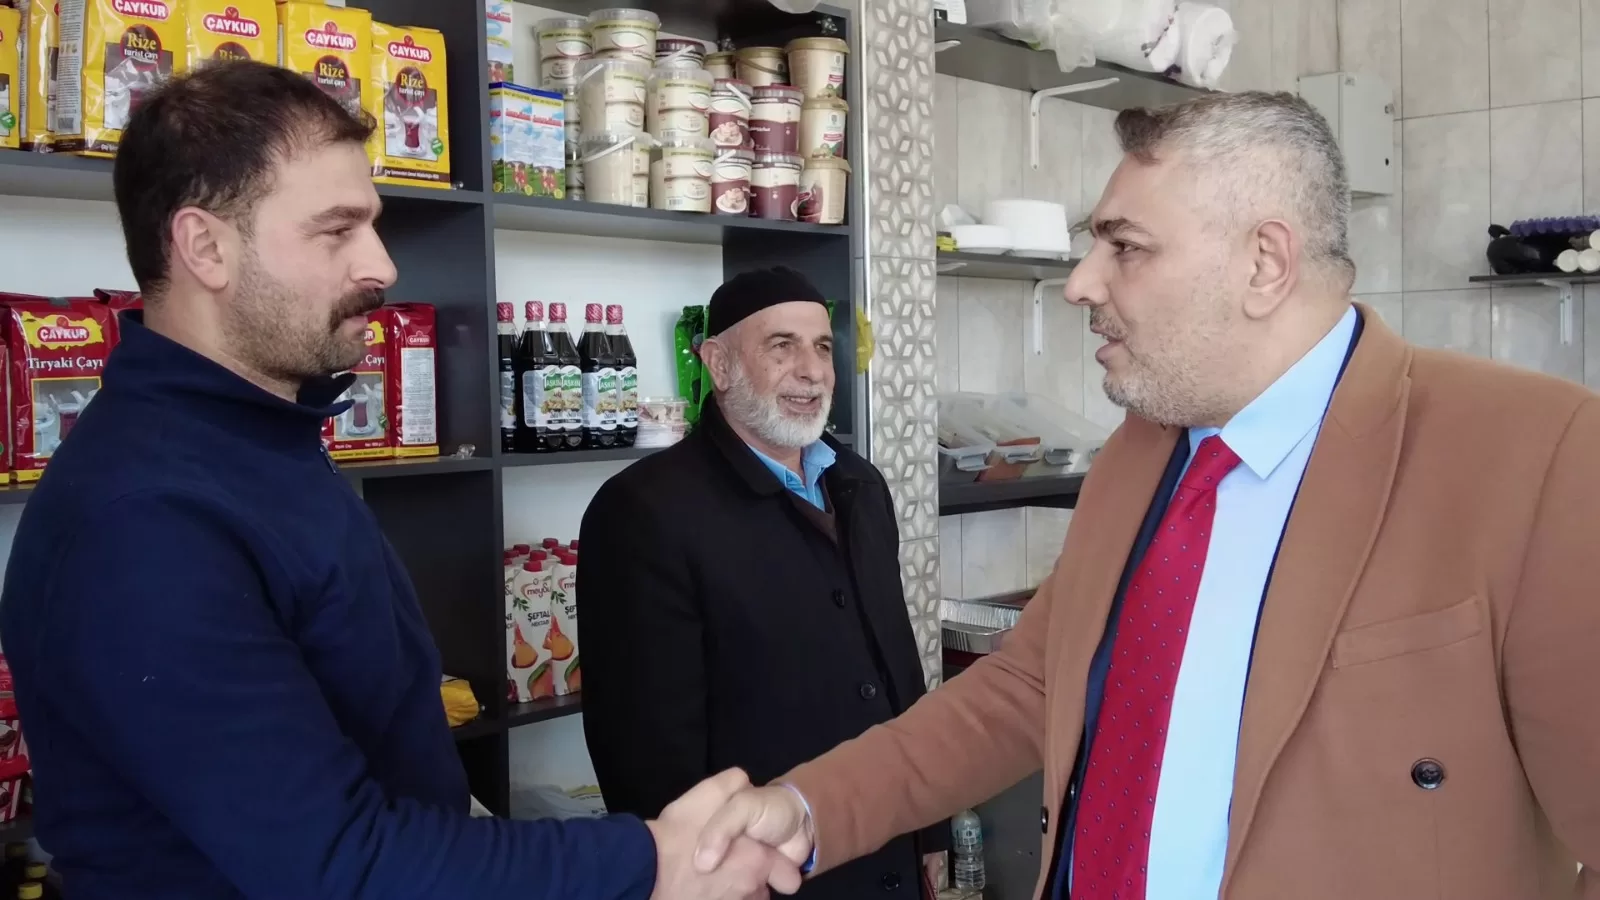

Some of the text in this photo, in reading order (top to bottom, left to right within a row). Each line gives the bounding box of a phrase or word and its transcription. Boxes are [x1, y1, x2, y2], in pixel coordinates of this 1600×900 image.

[114, 0, 166, 17] ÇAYKUR
[206, 17, 257, 35] ÇAYKUR
[126, 32, 157, 50] Rize
[307, 31, 354, 49] ÇAYKUR
[389, 44, 431, 60] ÇAYKUR
[319, 62, 346, 78] Rize
[400, 72, 424, 88] Rize
[40, 328, 88, 341] ÇAYKUR
[27, 356, 104, 371] Tiryaki Çayı
[365, 354, 385, 366] Çayı
[527, 611, 550, 622] ŞEFTAL
